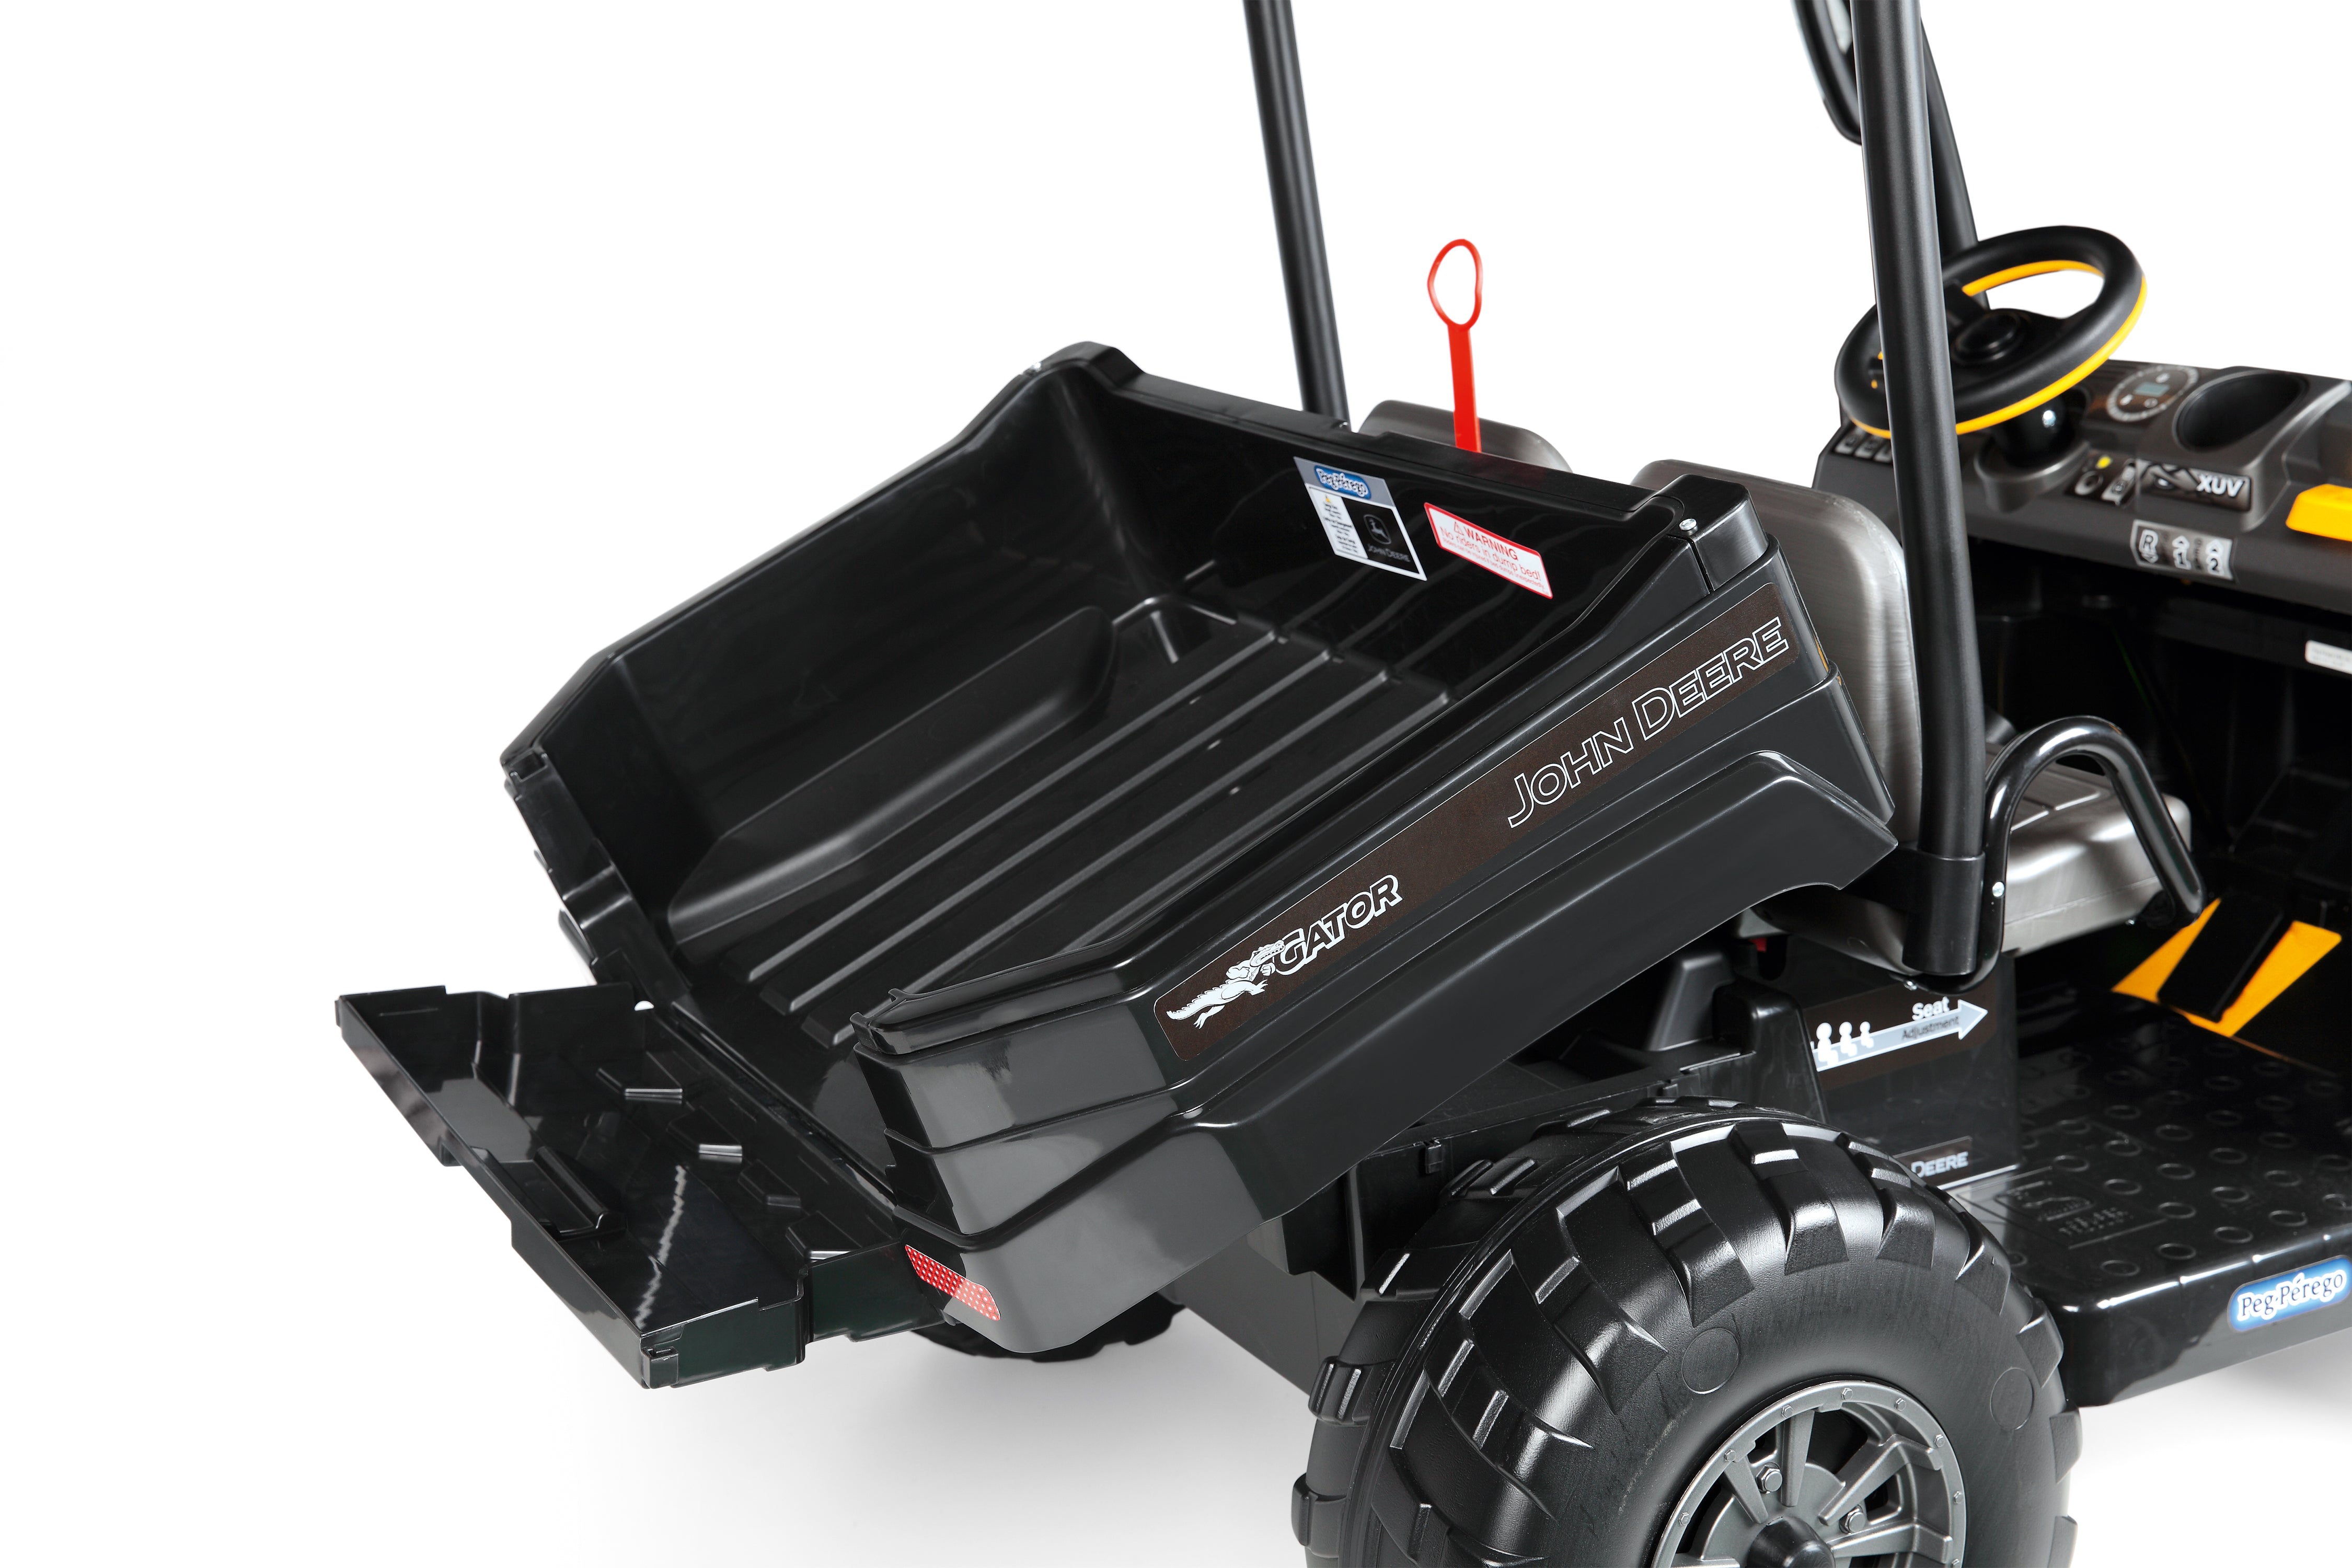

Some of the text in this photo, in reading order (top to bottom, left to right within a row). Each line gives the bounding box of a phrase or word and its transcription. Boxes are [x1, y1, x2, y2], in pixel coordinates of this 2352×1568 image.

[2196, 473, 2245, 497] XUV
[1440, 527, 1541, 581] No riders in dump bed!
[1464, 526, 1518, 561] WARNING
[2141, 533, 2155, 550] R
[1508, 616, 1789, 828] JOHN DEERE
[1274, 874, 1403, 975] GATOR
[1912, 996, 1950, 1020] Seat
[1903, 1016, 1959, 1040] Adjustment
[1911, 1151, 1968, 1178] DEERE
[2241, 1273, 2344, 1317] Peg-Pérego
